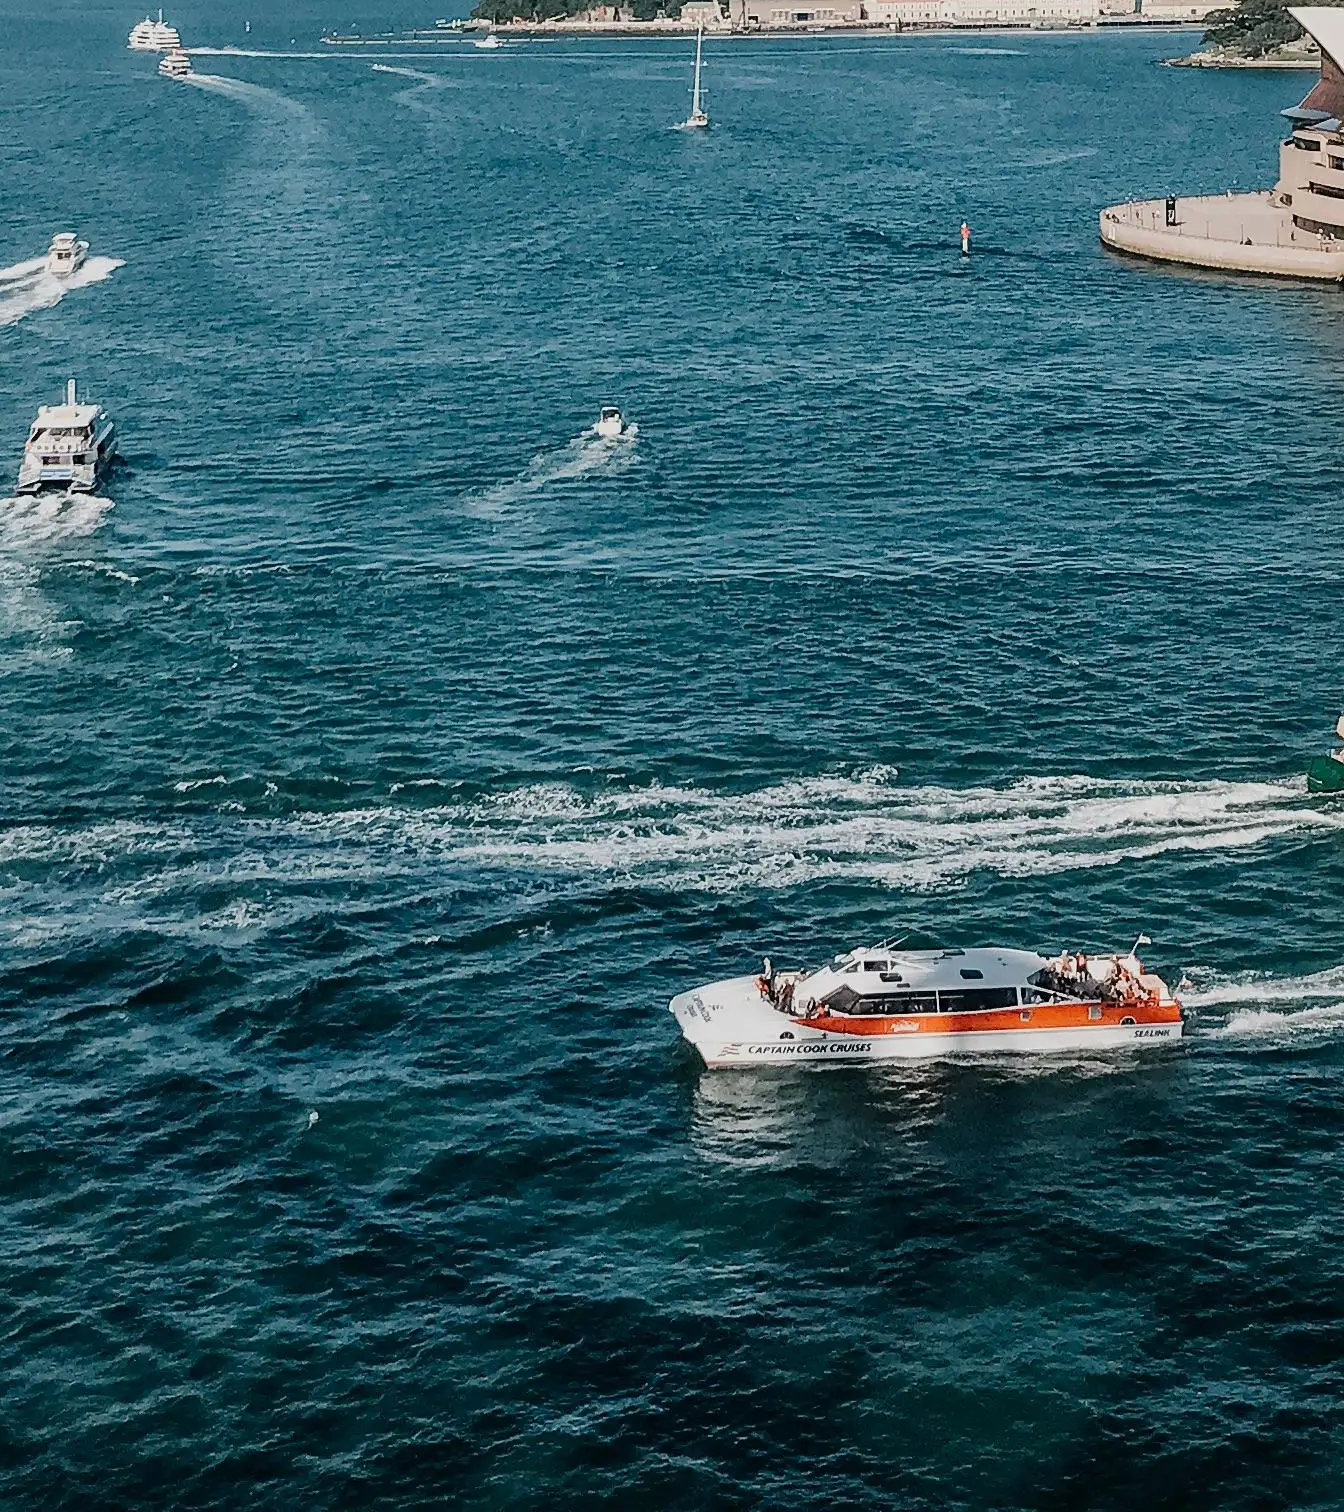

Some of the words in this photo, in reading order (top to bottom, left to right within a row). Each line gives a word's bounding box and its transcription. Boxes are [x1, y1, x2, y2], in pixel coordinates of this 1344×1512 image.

[748, 1044, 795, 1054] CAPTAIN
[796, 1043, 828, 1054] COOK
[829, 1042, 871, 1053] CRUISES
